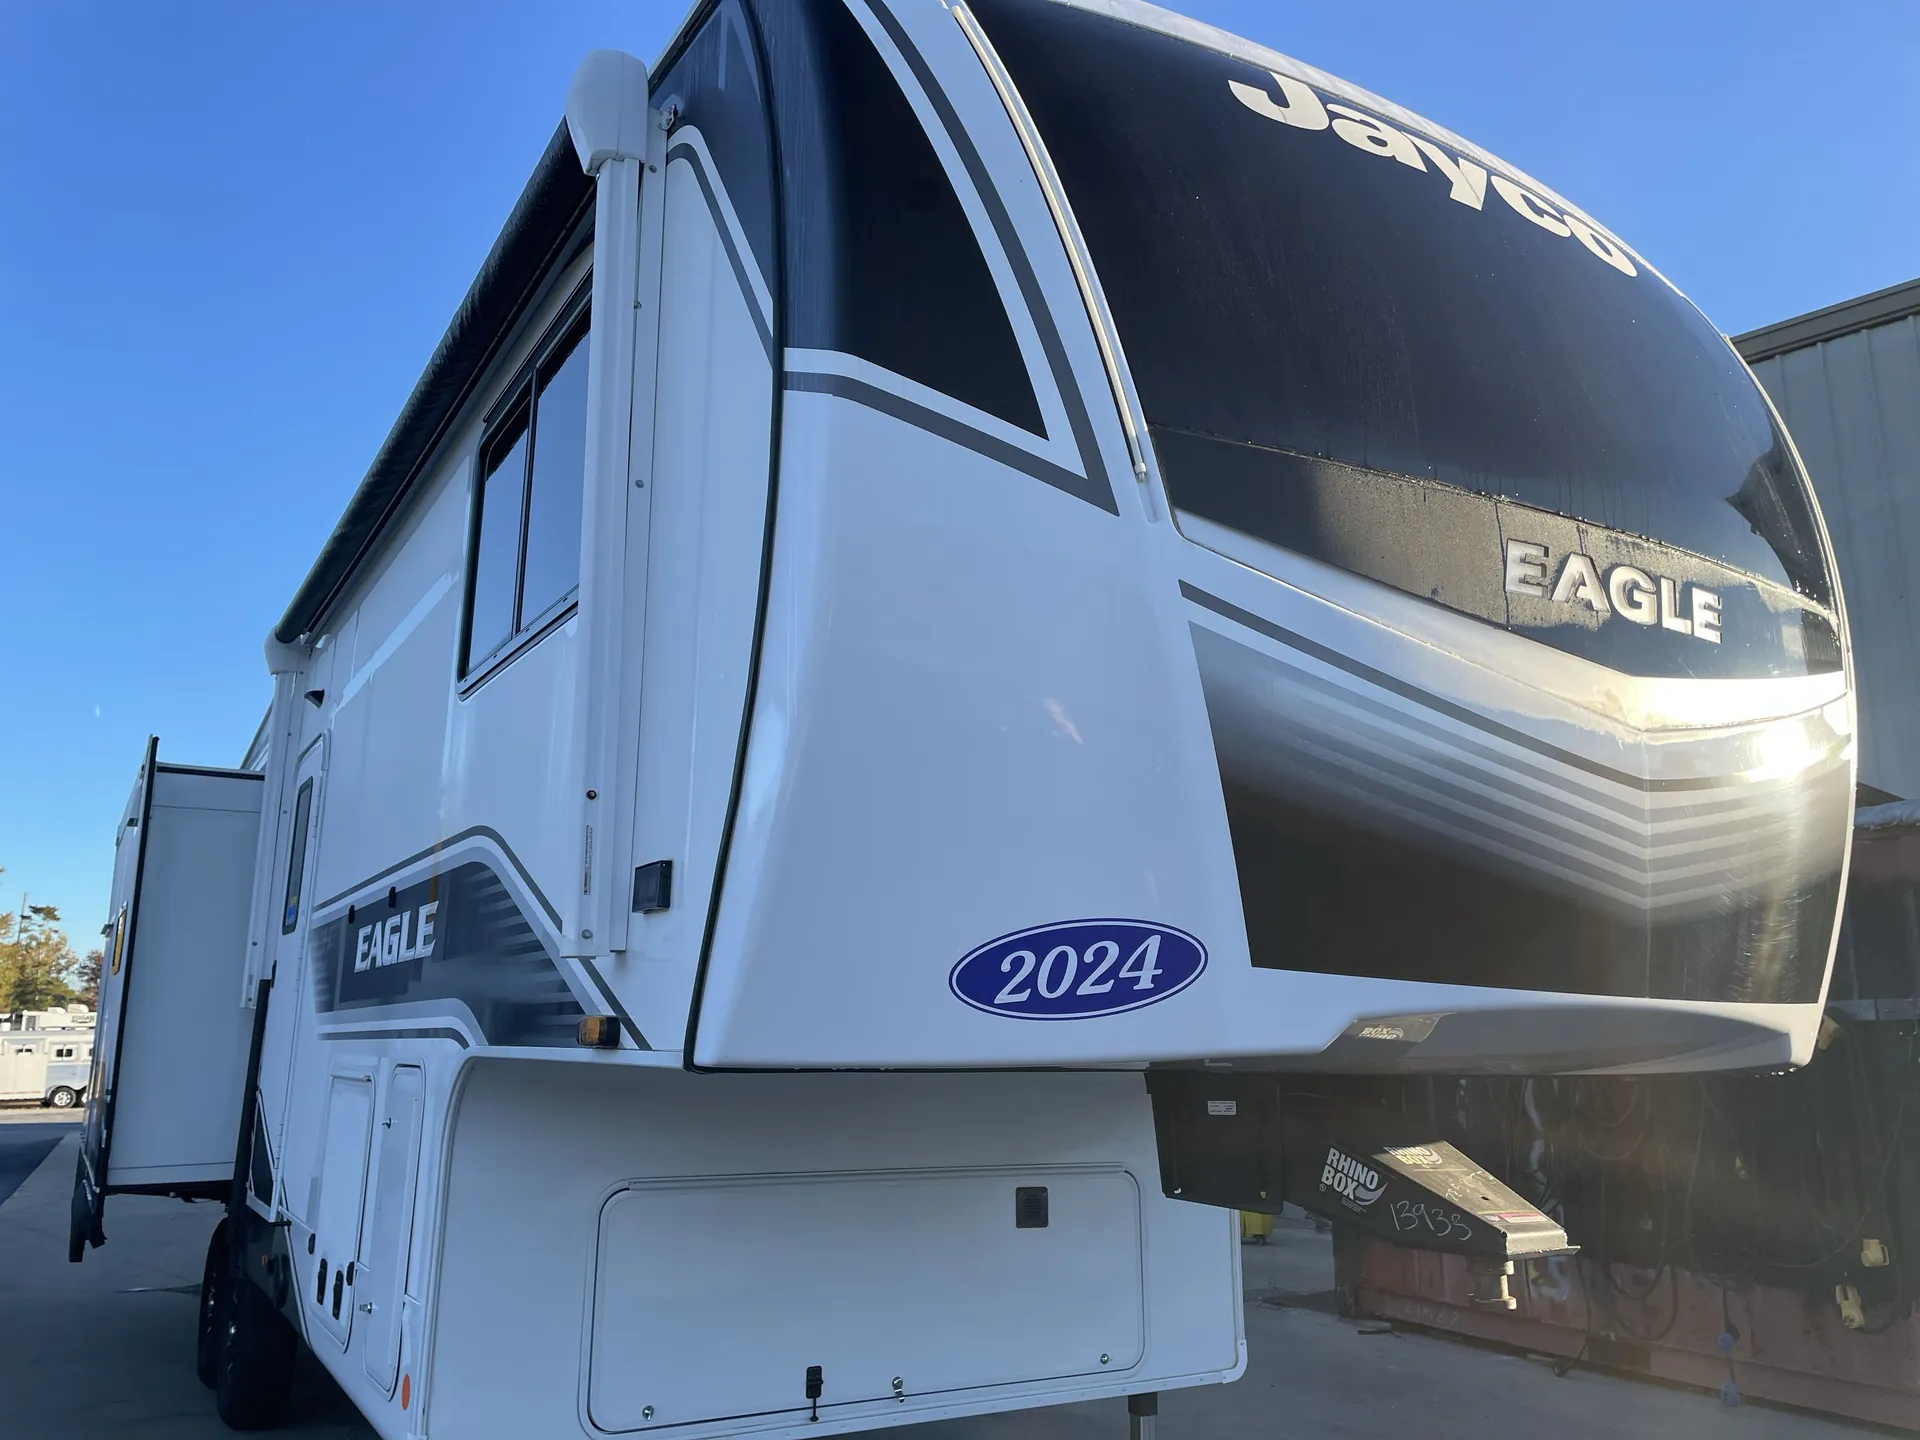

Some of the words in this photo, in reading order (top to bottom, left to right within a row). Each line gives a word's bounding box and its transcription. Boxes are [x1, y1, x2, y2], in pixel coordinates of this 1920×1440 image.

[1228, 71, 1637, 277] Jayco
[1505, 538, 1723, 644] EAGLE
[354, 900, 439, 973] EAGLE
[994, 934, 1163, 1004] 2024
[1321, 1164, 1359, 1200] BOX
[1326, 1147, 1379, 1190] RHINO
